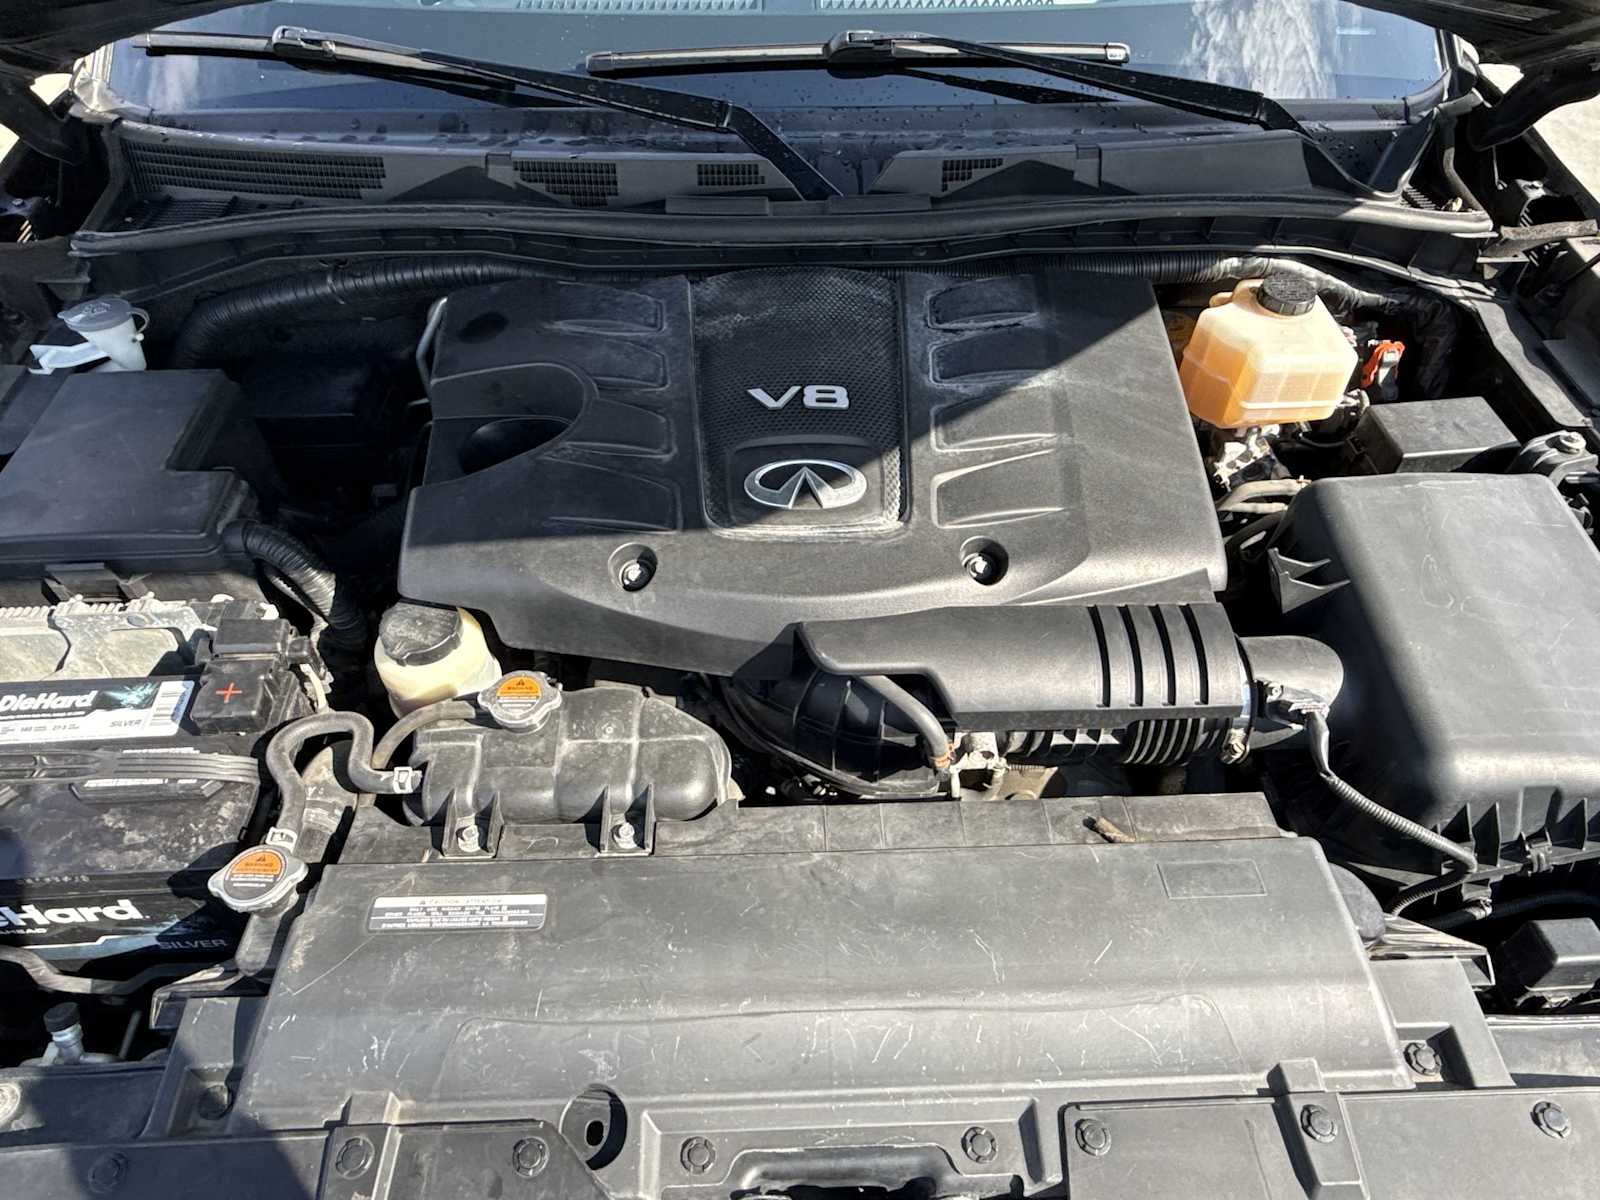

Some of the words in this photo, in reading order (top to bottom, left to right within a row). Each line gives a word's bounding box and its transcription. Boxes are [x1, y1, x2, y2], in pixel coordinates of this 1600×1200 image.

[747, 385, 850, 410] V8
[0, 690, 98, 711] DieHard
[158, 938, 228, 950] SILVER
